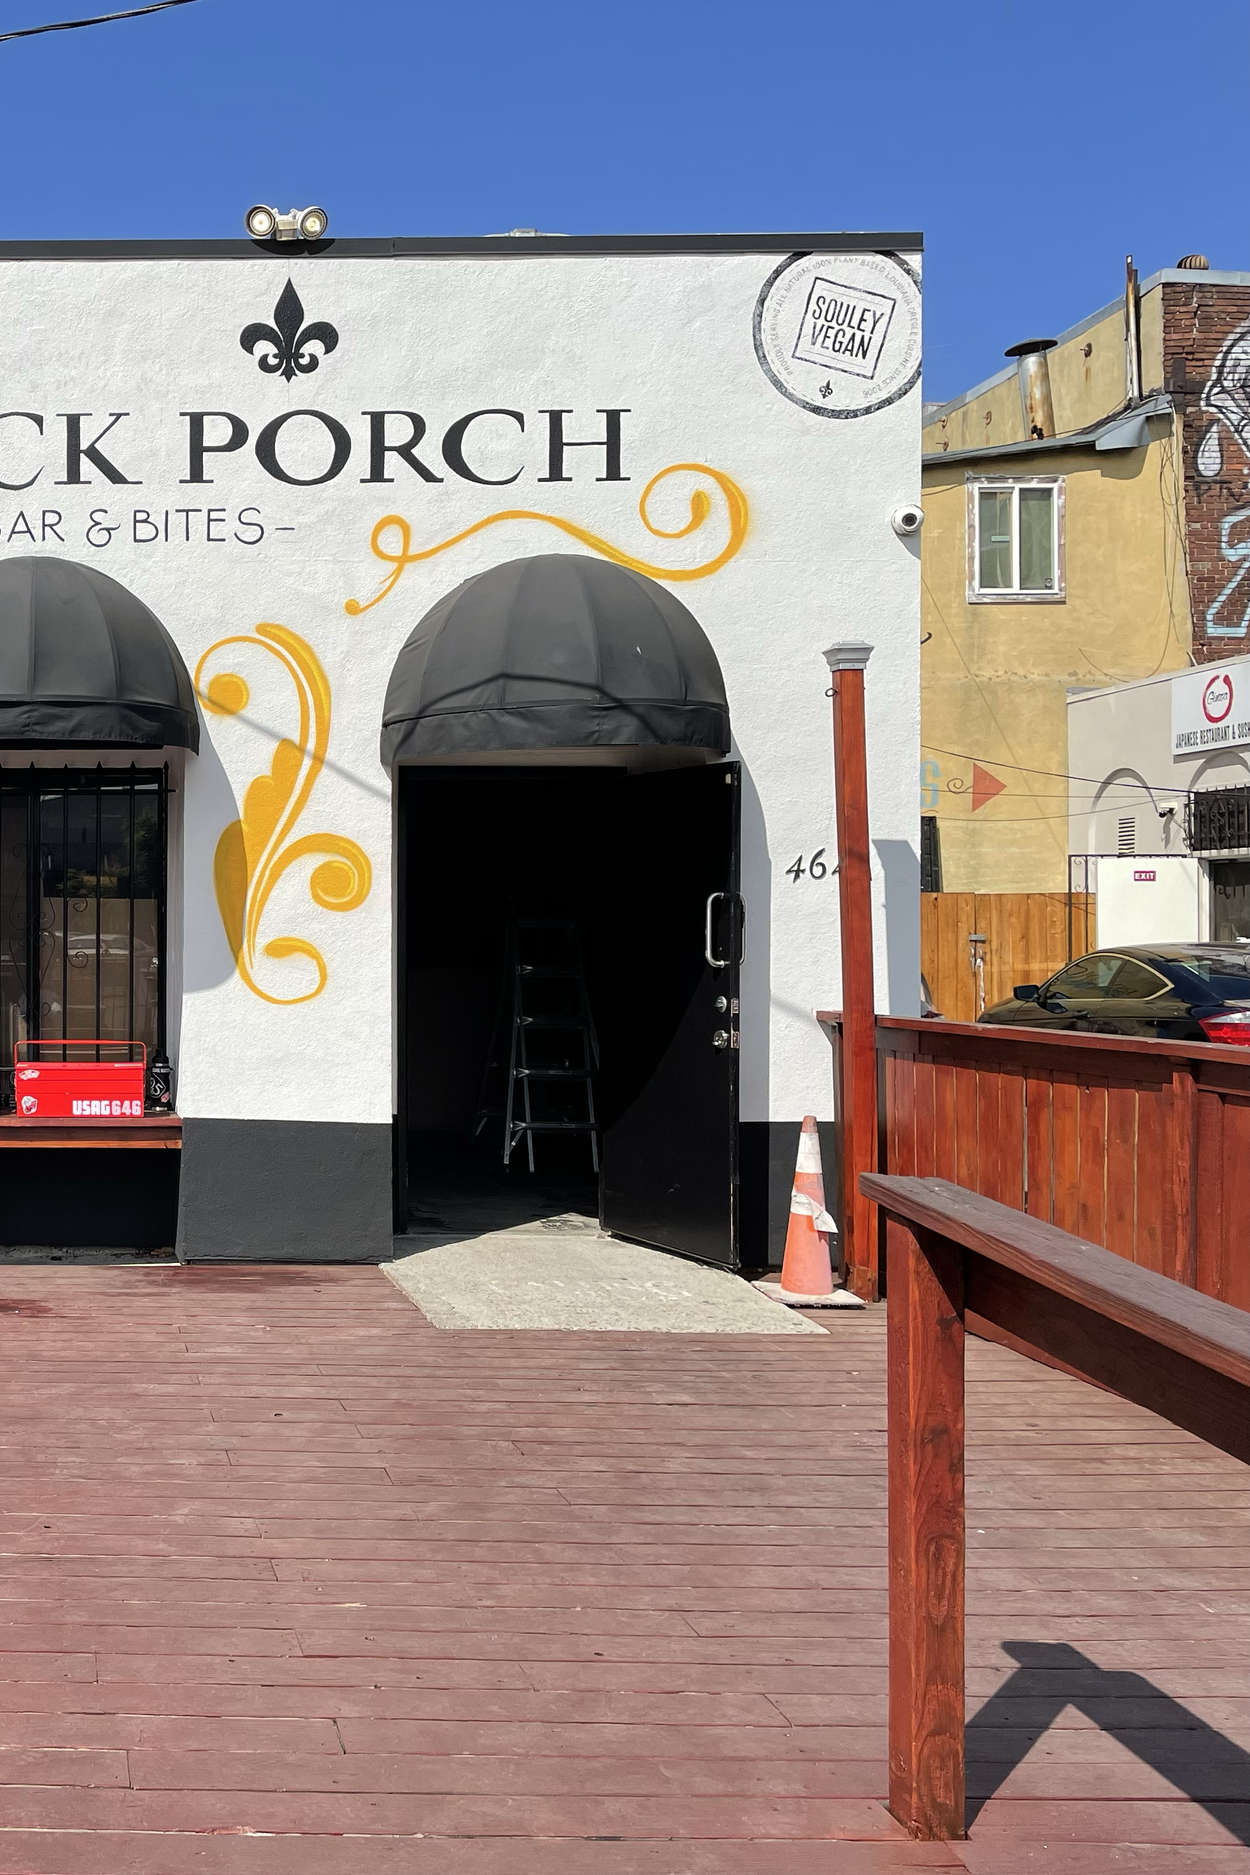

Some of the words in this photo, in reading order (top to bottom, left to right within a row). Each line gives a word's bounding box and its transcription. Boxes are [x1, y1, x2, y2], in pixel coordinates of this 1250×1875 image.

[775, 294, 788, 308] ALL
[784, 266, 812, 293] NATURAL
[812, 258, 832, 270] 100%
[859, 258, 886, 273] BASED
[811, 295, 885, 335] SOULEY
[810, 321, 874, 360] VEGAN
[179, 408, 632, 487] PORCH
[86, 508, 121, 548] &
[1175, 730, 1199, 750] JAPANESE
[1199, 724, 1230, 745] RESTAURANT
[1231, 723, 1237, 740] &
[785, 847, 840, 884] 46
[1134, 872, 1155, 880] EXIT
[72, 1100, 111, 1116] USAG
[111, 1100, 142, 1116] 646
